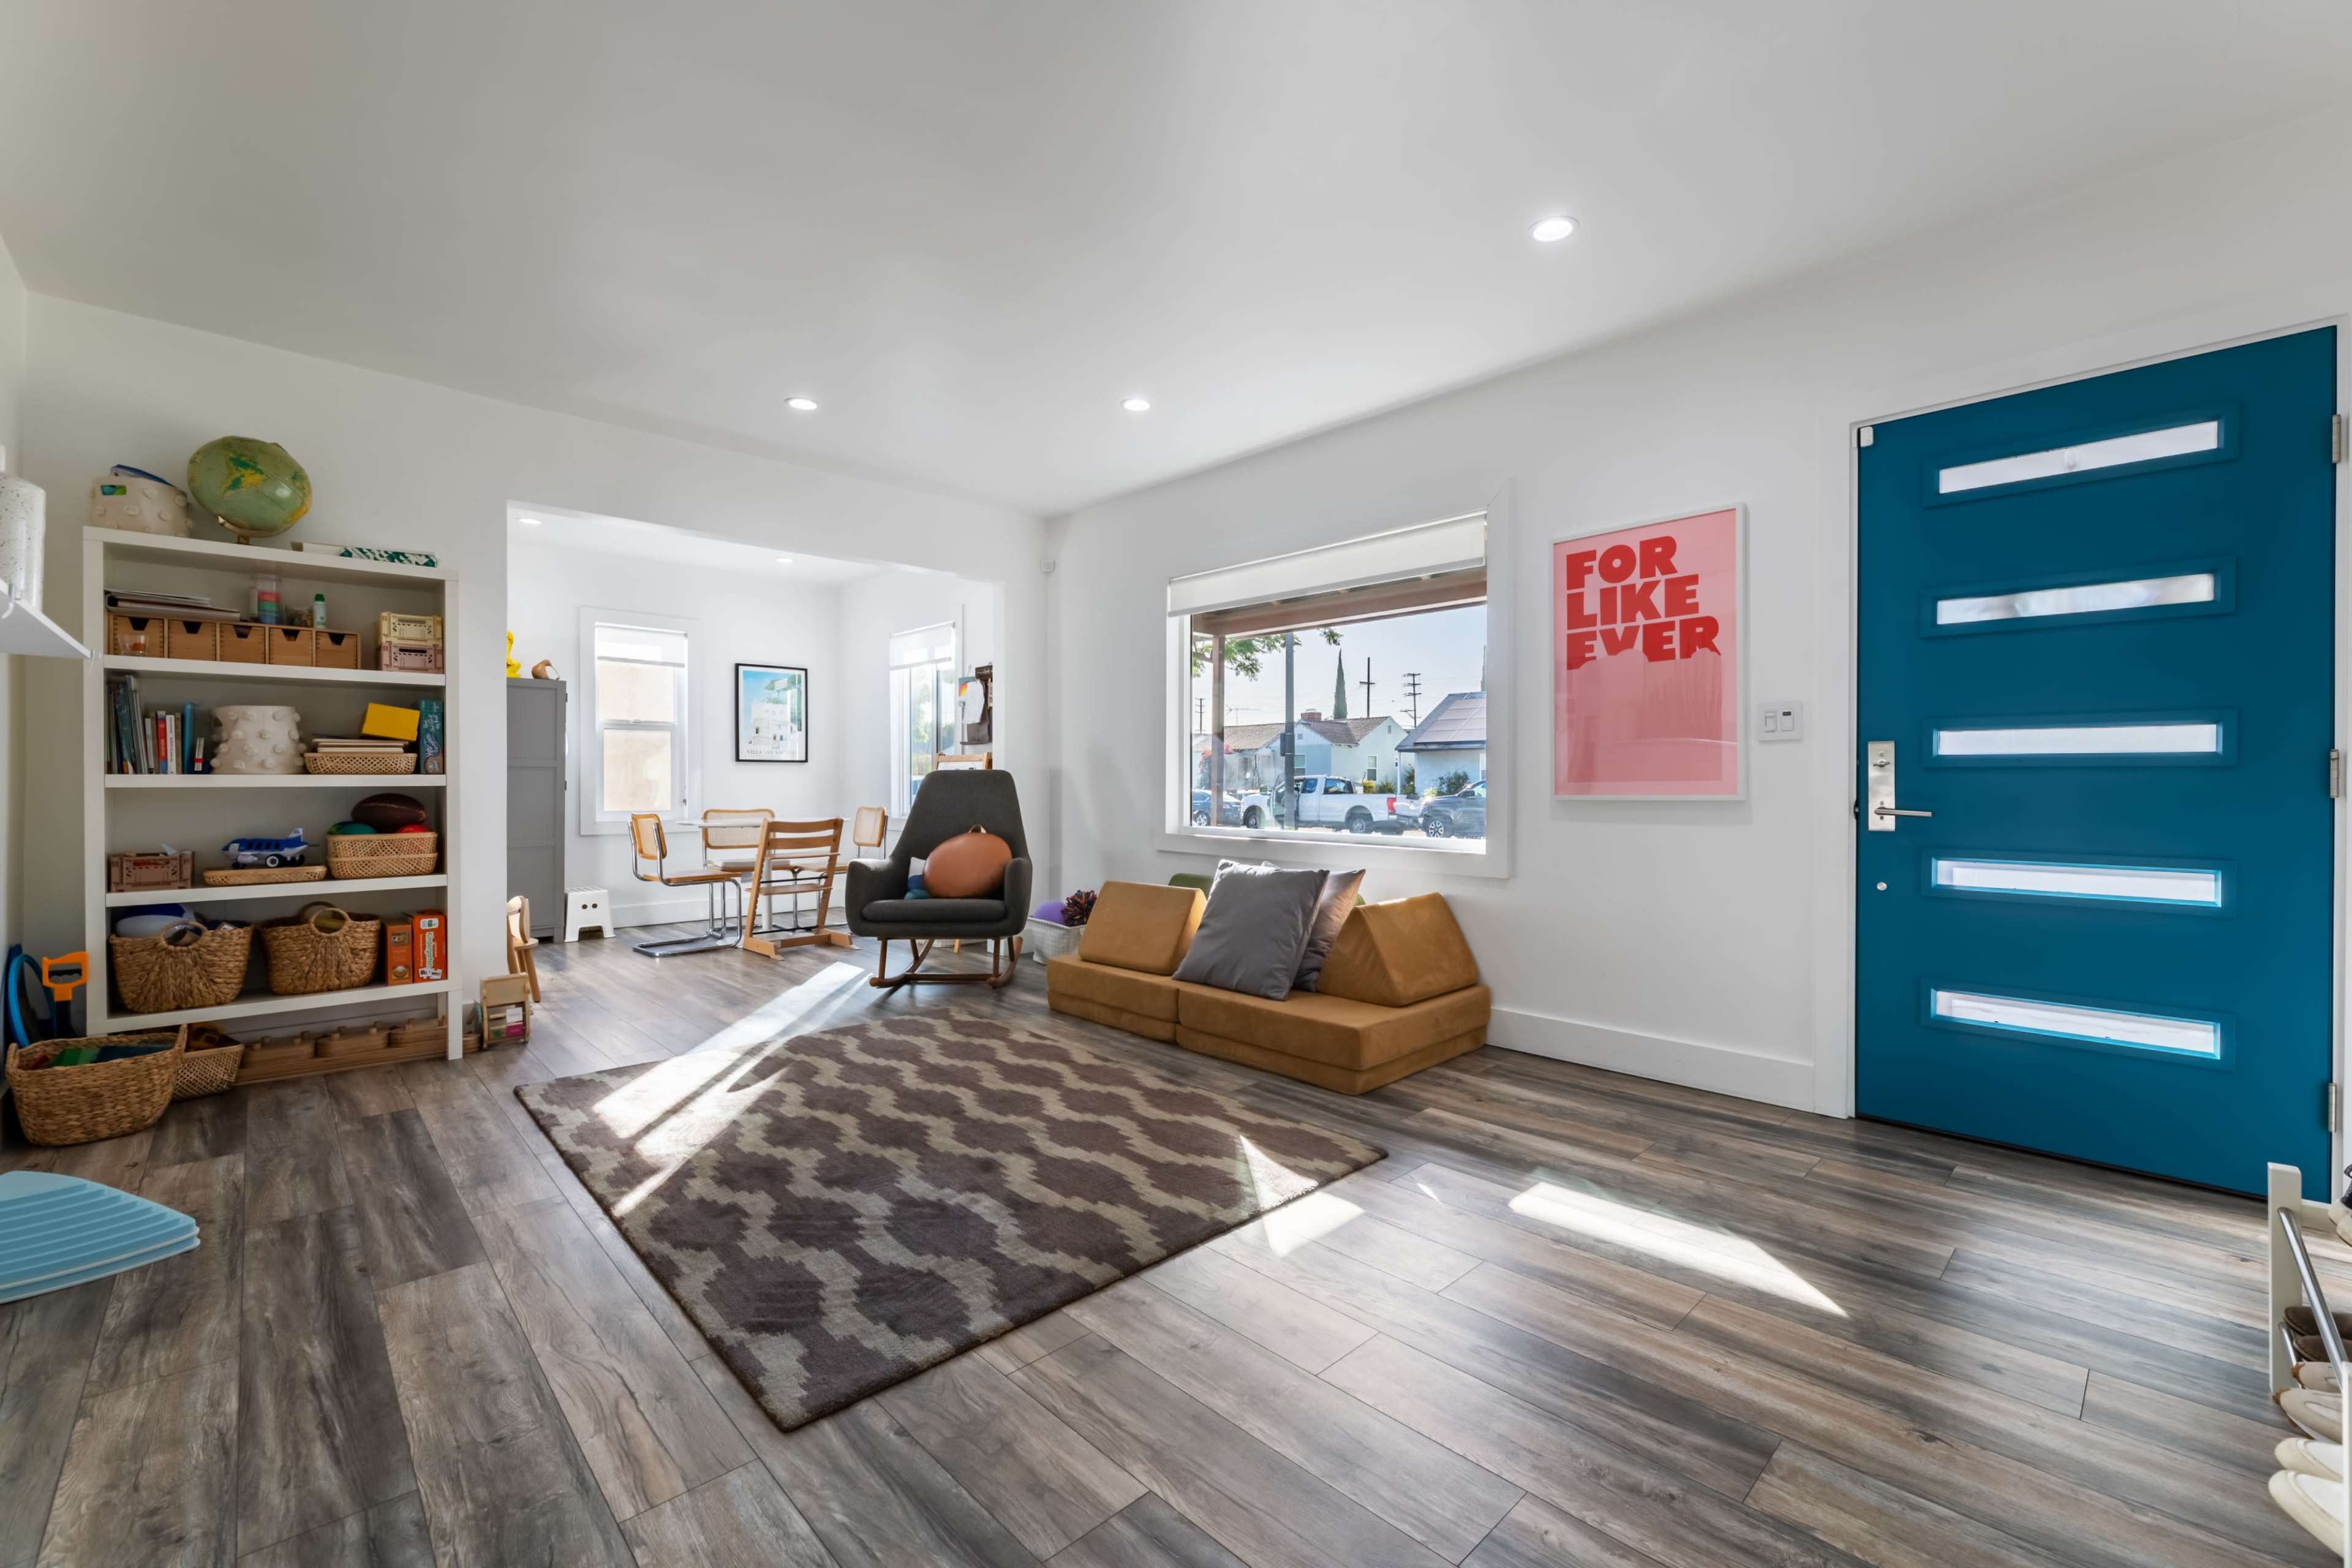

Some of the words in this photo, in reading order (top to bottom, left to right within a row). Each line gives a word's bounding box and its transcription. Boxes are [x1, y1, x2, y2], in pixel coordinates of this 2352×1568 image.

[1566, 535, 1678, 590] FOR
[1566, 574, 1699, 630] LIKE
[1566, 616, 1722, 670] EVER
[425, 932, 434, 968] Kindergarten
